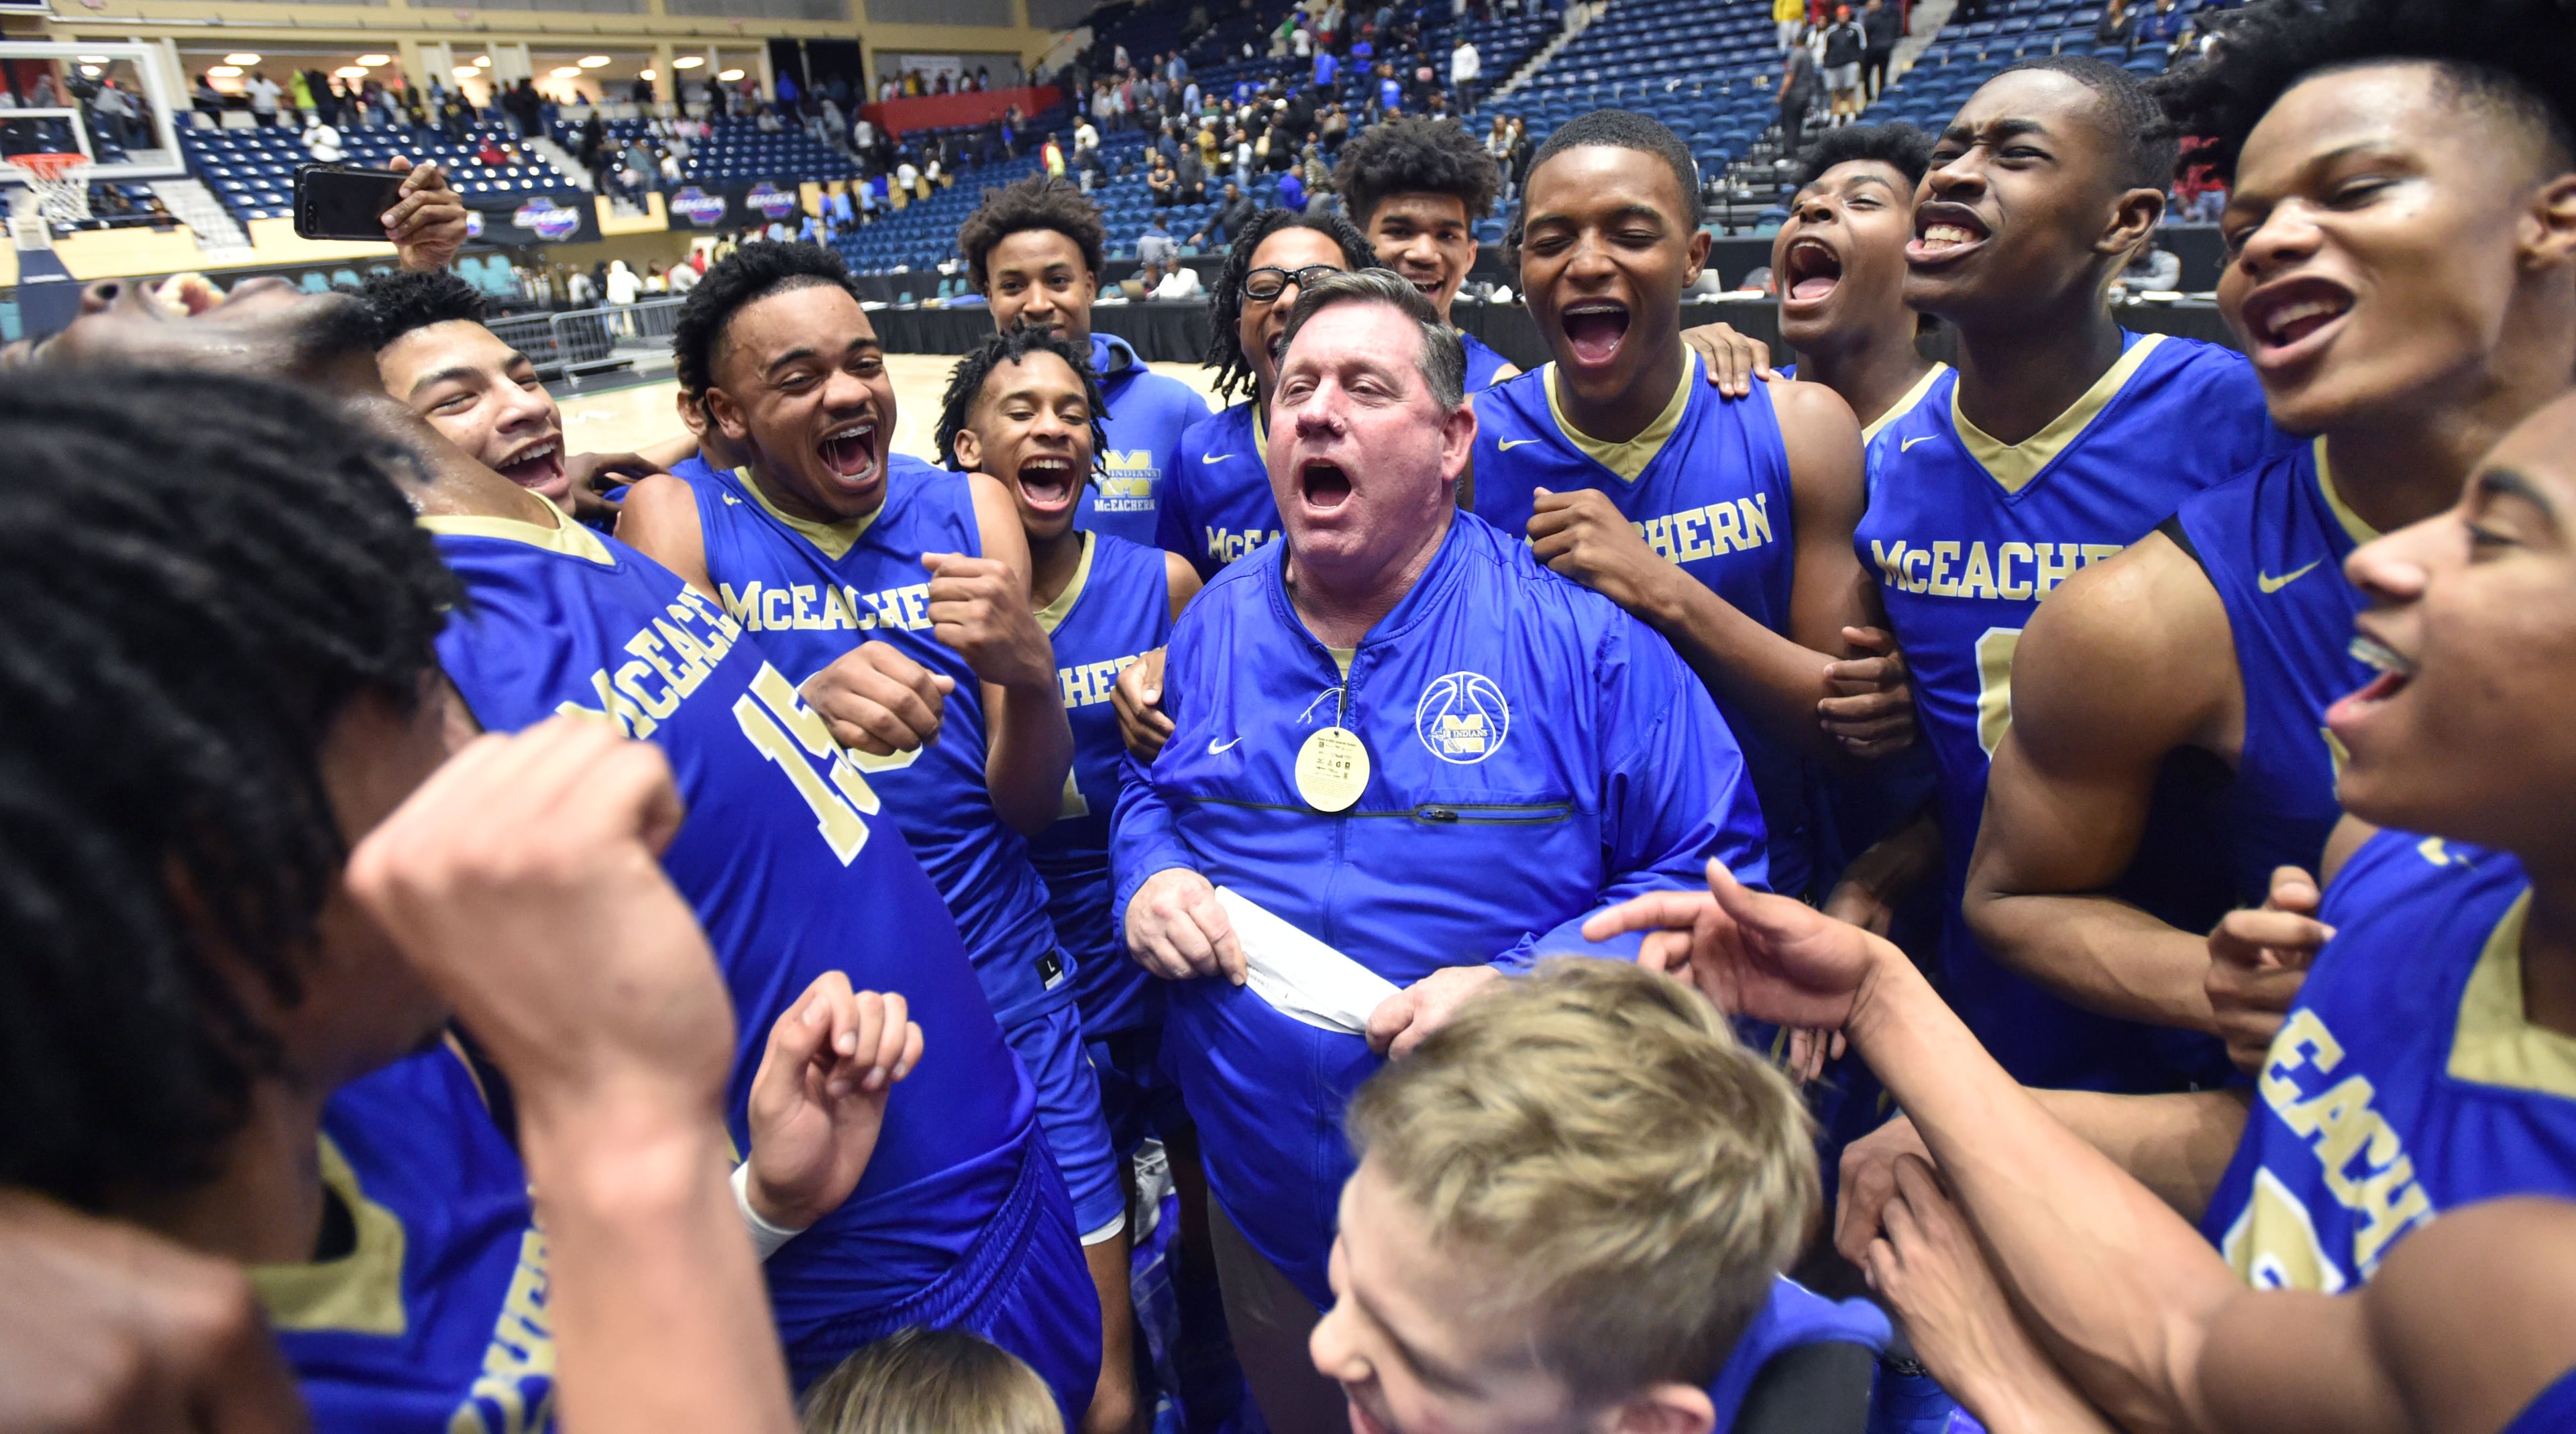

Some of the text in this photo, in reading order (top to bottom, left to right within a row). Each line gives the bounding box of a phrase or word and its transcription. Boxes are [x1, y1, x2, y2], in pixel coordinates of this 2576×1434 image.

[1093, 498, 1155, 512] McEACHERN
[719, 581, 934, 632] McEACHE
[1453, 728, 1489, 738] INDIANS
[2258, 1006, 2437, 1282] EACH
